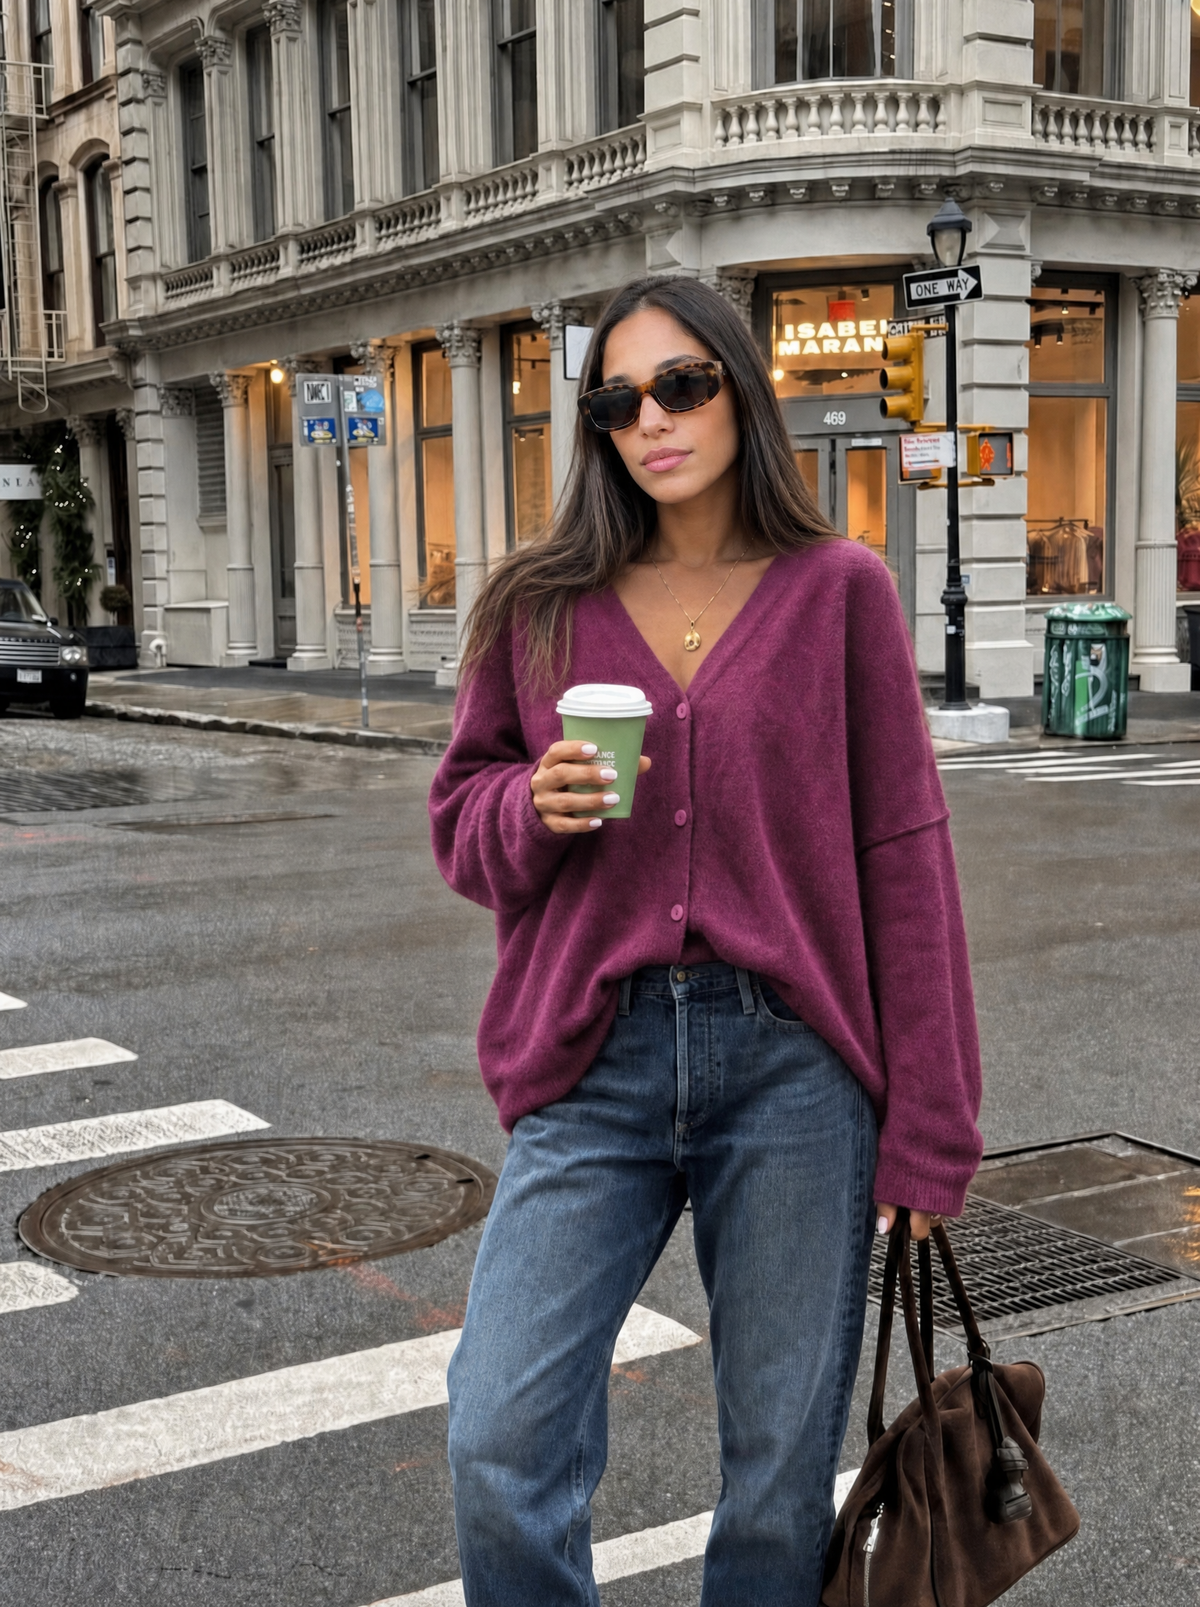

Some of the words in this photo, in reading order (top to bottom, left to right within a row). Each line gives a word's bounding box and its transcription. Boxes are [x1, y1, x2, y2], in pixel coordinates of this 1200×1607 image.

[915, 282, 939, 297] ONE
[946, 277, 969, 293] WAY
[823, 411, 846, 425] 469
